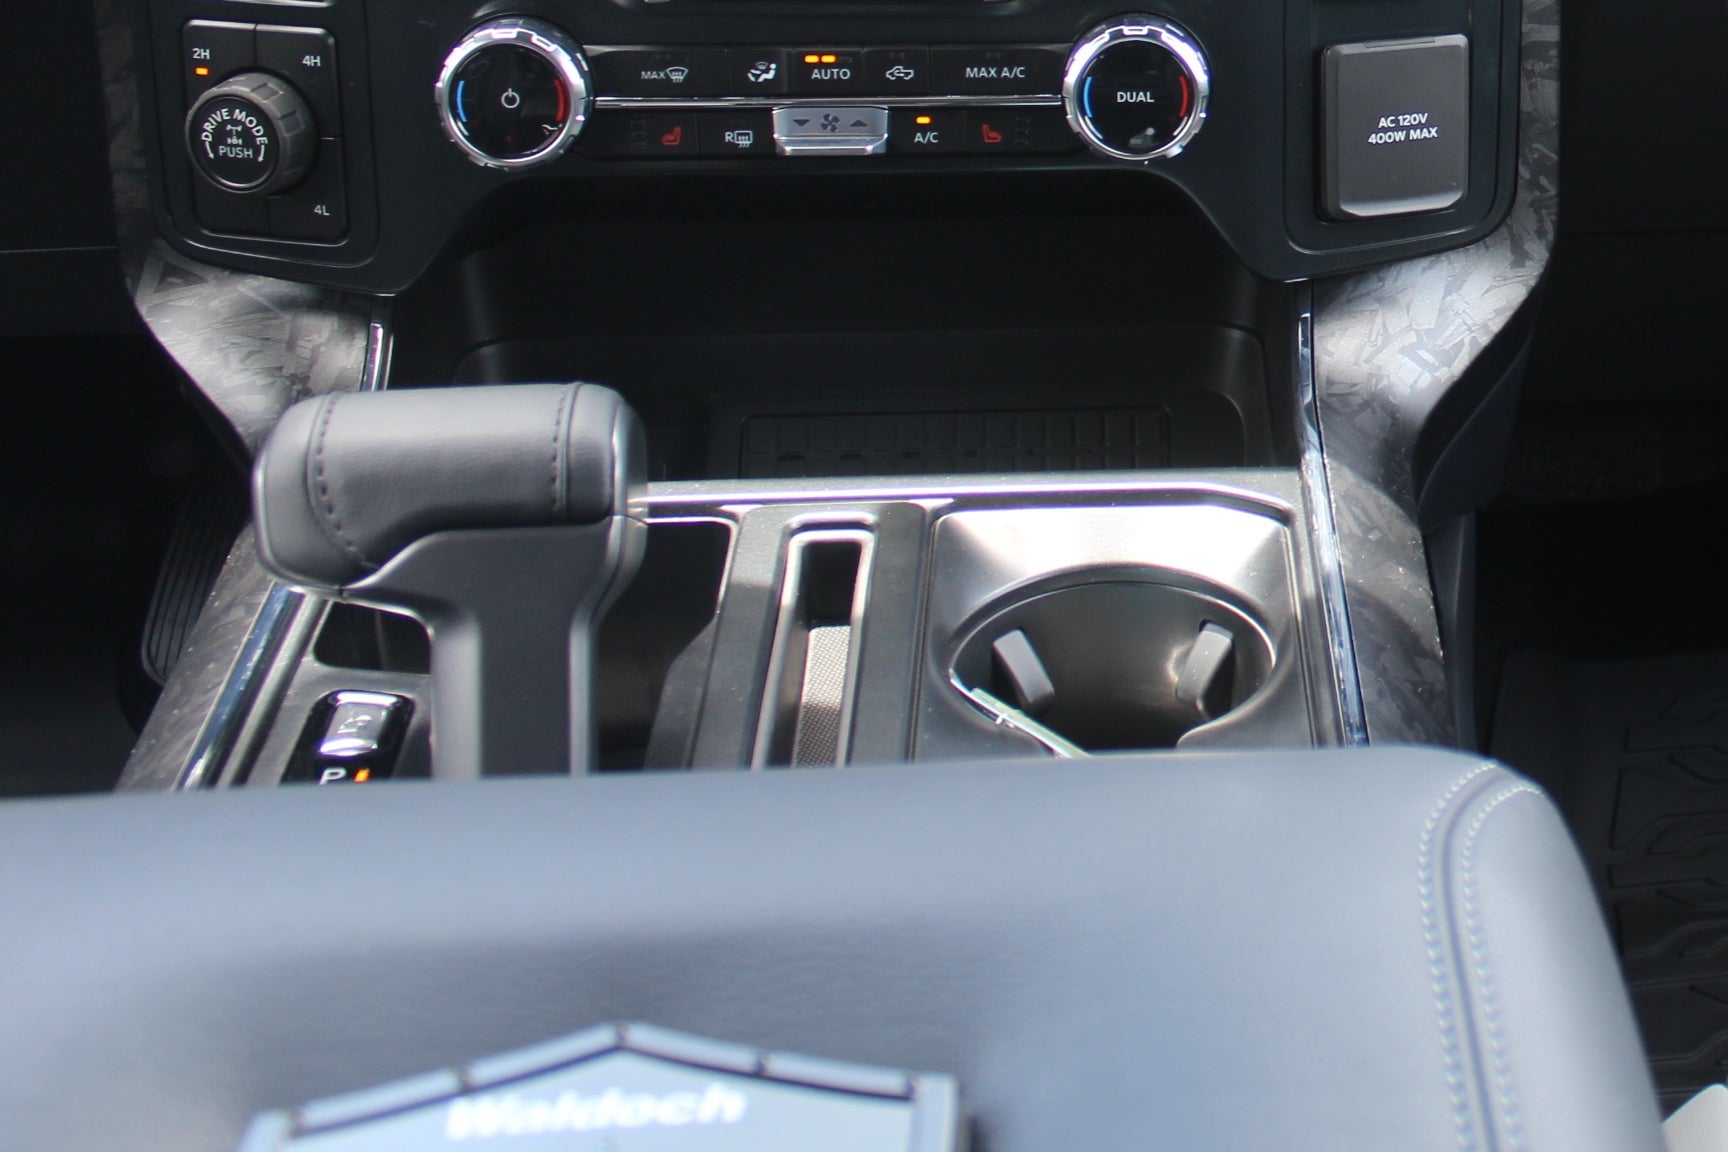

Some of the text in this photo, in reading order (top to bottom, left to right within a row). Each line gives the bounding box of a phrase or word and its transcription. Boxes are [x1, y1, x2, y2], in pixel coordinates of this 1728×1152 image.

[192, 48, 211, 60] 2H
[302, 55, 321, 67] 4H
[641, 70, 666, 80] MAX
[811, 68, 851, 80] AUTO
[965, 66, 1026, 79] MAX A/C
[1117, 91, 1154, 103] DUAL
[201, 108, 268, 145] DRIVE MODE
[1378, 113, 1428, 129] AC 120V
[914, 132, 939, 144] A/C
[1368, 127, 1438, 144] 400W MAX
[218, 145, 253, 159] PUSH
[313, 205, 331, 216] 4L
[319, 767, 347, 785] P
[447, 1082, 747, 1141] Waldoch
